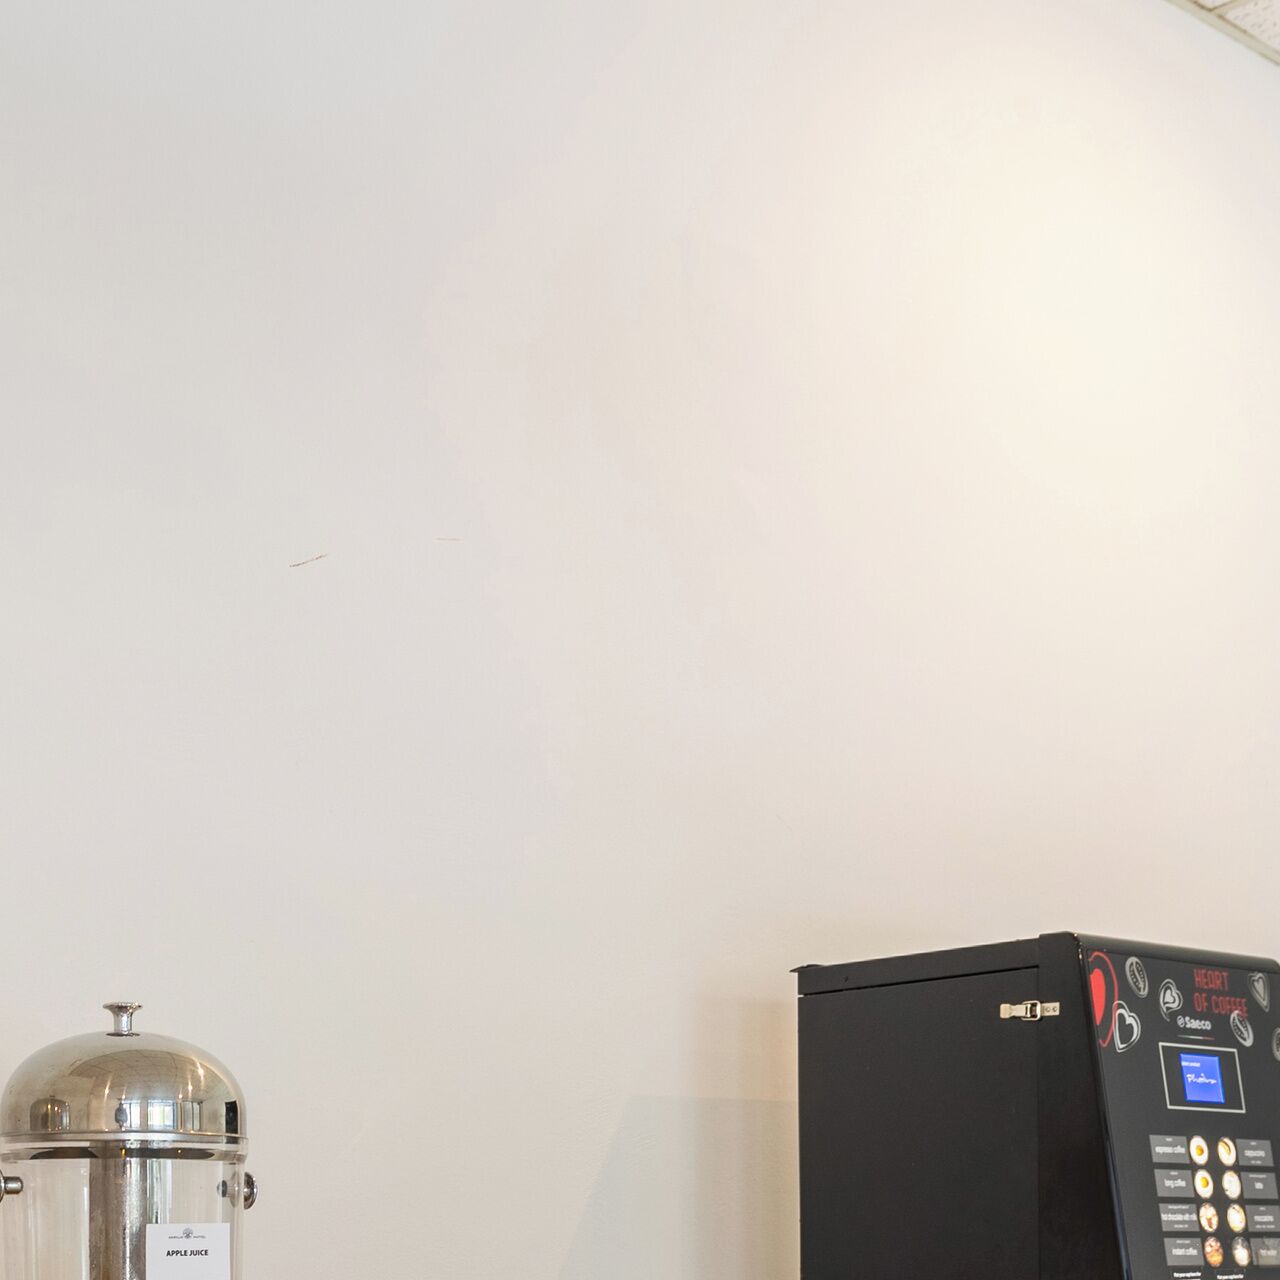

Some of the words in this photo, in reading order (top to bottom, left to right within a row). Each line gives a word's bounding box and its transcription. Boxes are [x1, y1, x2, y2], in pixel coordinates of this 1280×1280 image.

[1193, 969, 1229, 991] HEART
[1193, 992, 1208, 1012] OF
[1211, 995, 1248, 1020] COFFEE
[1184, 1016, 1212, 1031] Saeco
[166, 1249, 188, 1257] APPLE
[189, 1249, 209, 1257] JUICE
